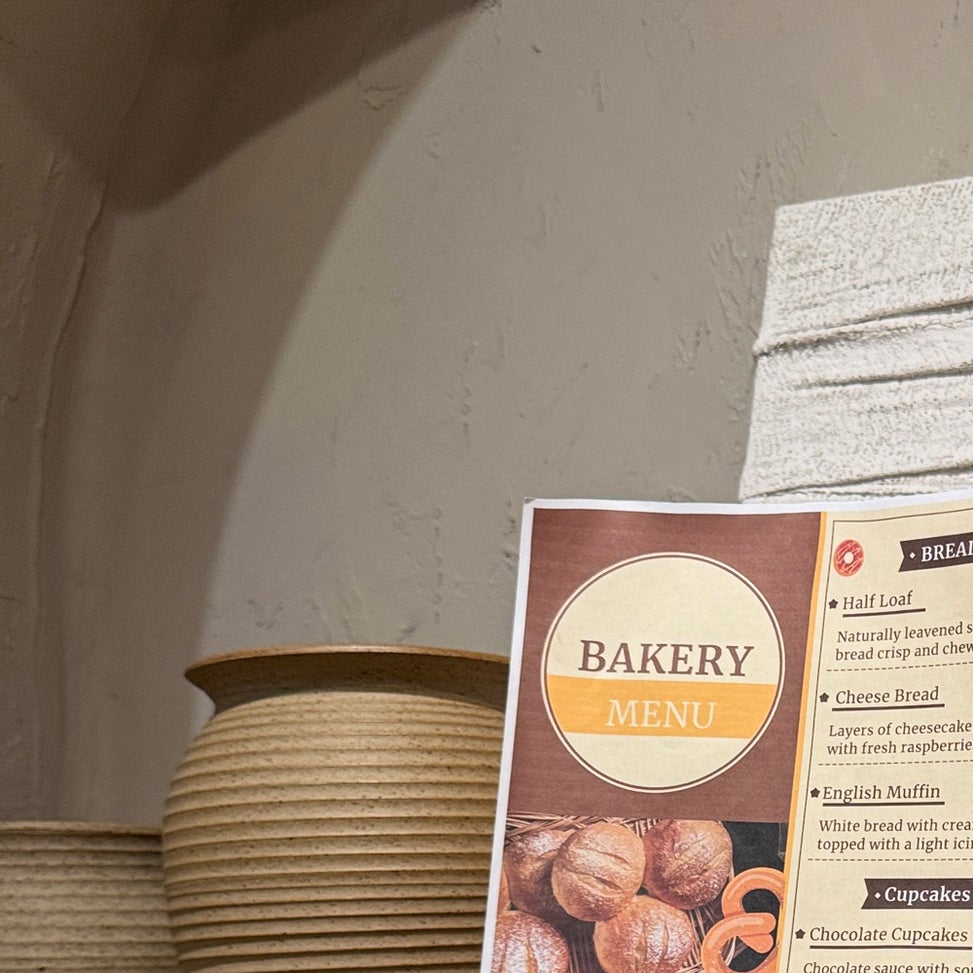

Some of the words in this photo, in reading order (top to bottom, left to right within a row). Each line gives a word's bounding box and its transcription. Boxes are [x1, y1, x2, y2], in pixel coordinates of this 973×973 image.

[842, 594, 876, 610] Half
[880, 590, 912, 608] Loaf
[838, 627, 901, 643] Naturally
[904, 622, 963, 640] leavened
[578, 640, 754, 676] BAKERY
[836, 648, 873, 661] bread
[877, 646, 910, 660] crisp
[914, 642, 938, 656] and
[836, 690, 890, 704] Cheese
[894, 686, 939, 702] Bread
[606, 699, 716, 729] MENU
[829, 724, 874, 740] Layers
[877, 721, 892, 736] of
[827, 741, 855, 755] with
[862, 739, 897, 754] fresh
[823, 784, 882, 804] English
[886, 784, 940, 799] Muffin
[819, 818, 860, 832] White
[864, 818, 902, 832] bread
[906, 818, 938, 831] with
[817, 838, 865, 854] topped
[869, 837, 900, 850] with
[904, 840, 912, 850] a
[916, 836, 948, 852] light
[884, 886, 971, 906] Cupcakes
[810, 928, 887, 942] Chocolate
[891, 927, 968, 944] Cupcakes
